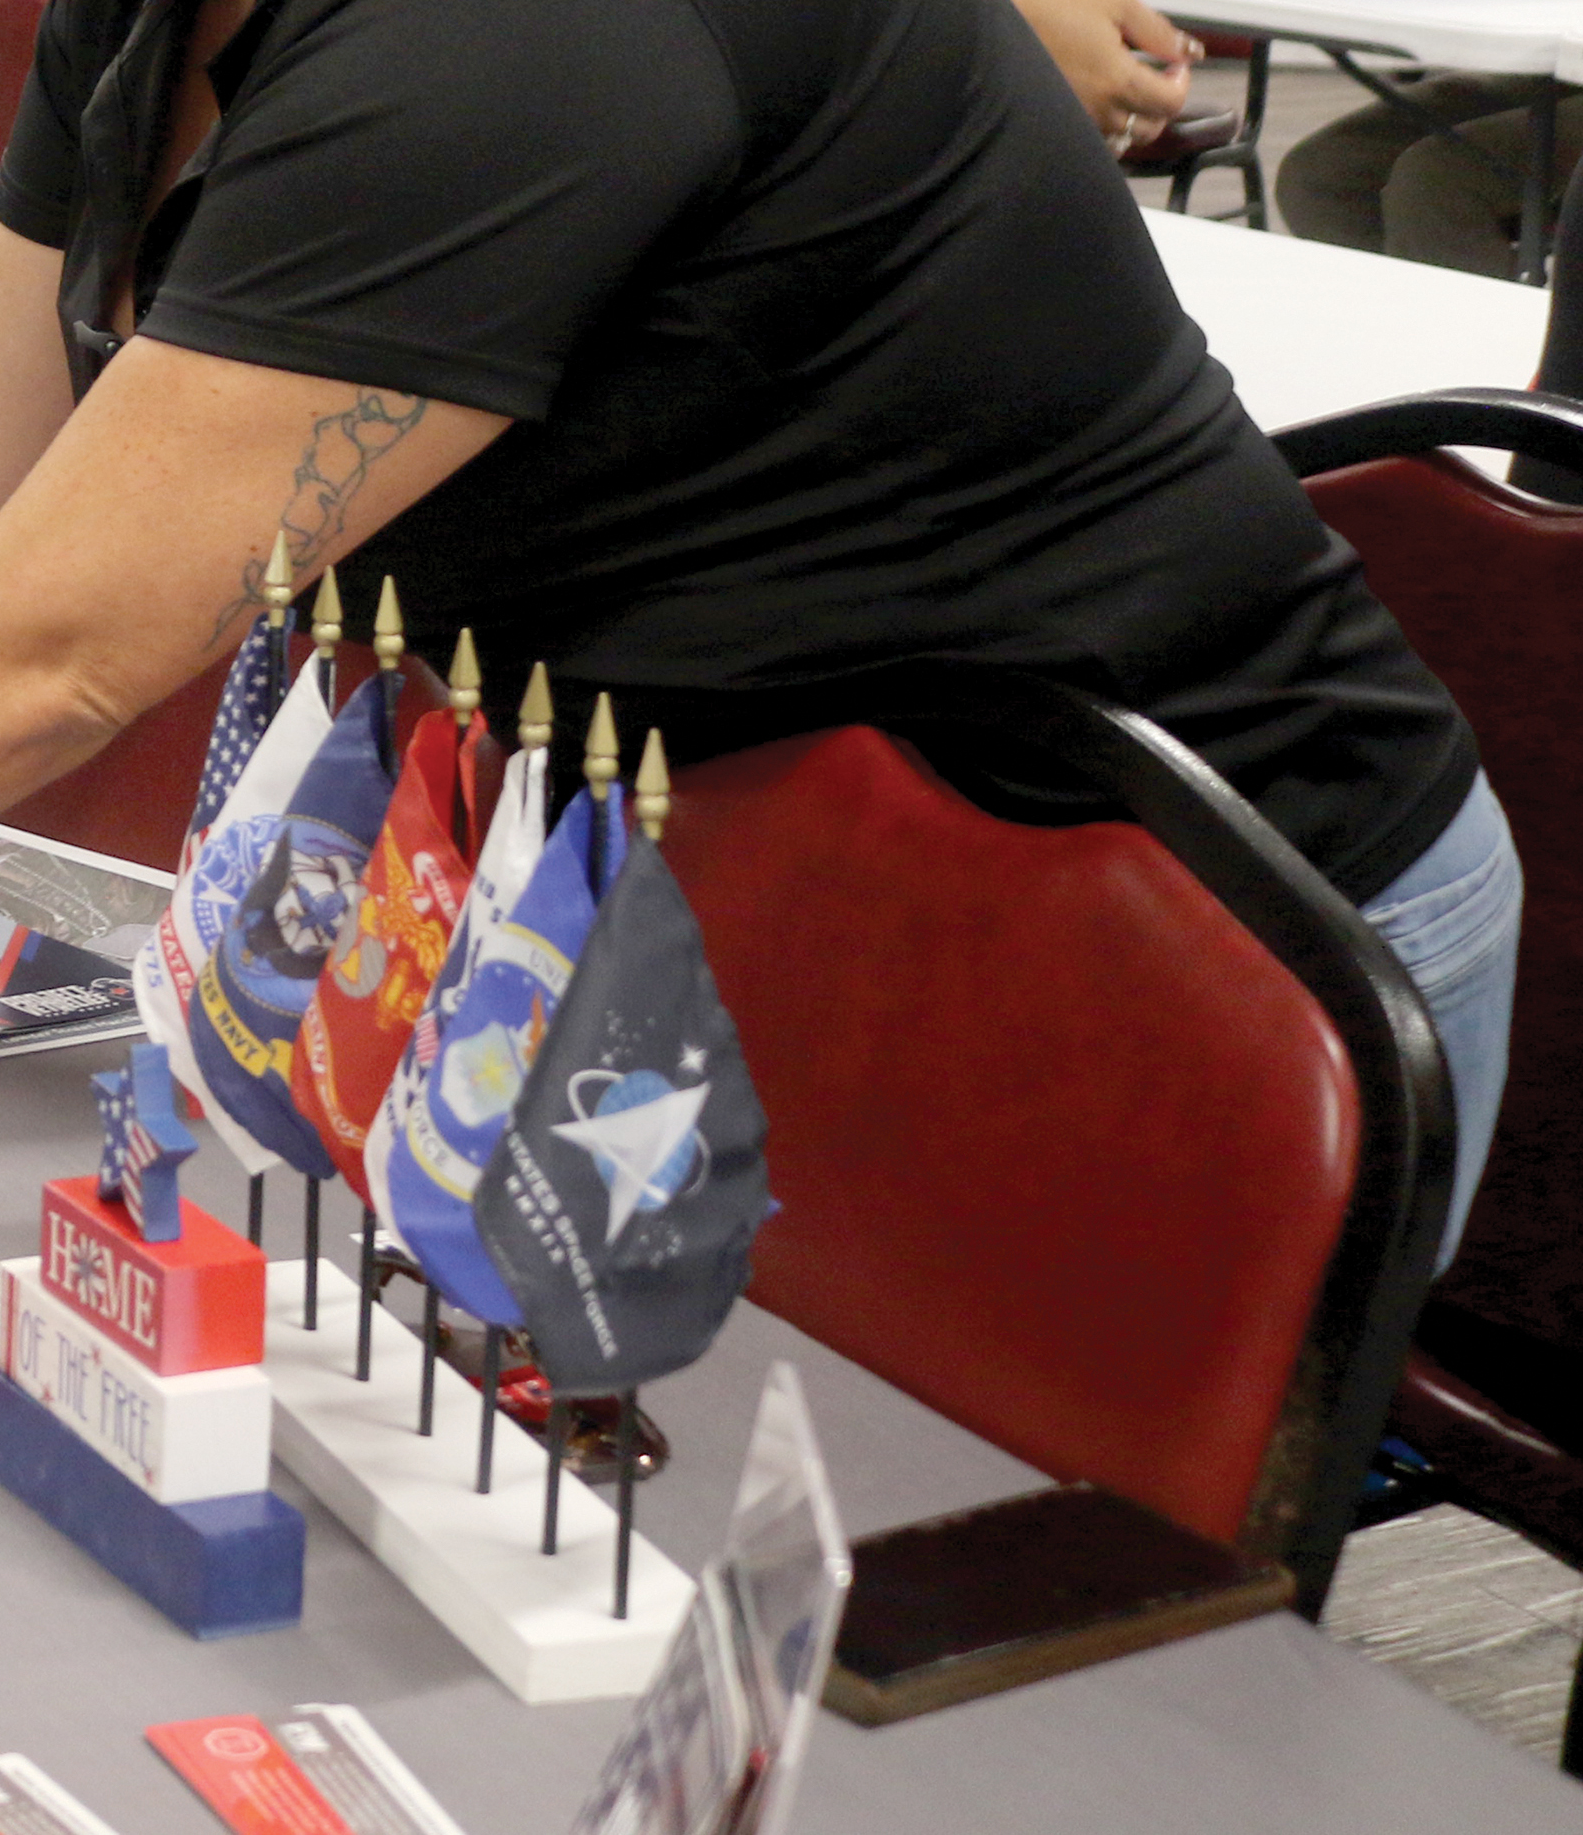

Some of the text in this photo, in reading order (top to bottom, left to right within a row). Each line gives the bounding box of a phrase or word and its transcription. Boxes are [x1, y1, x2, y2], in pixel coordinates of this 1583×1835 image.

[217, 1010, 260, 1062] NAVY
[507, 1130, 620, 1359] STATES SPACE FORCE
[19, 1308, 151, 1475] OF THE FREE
